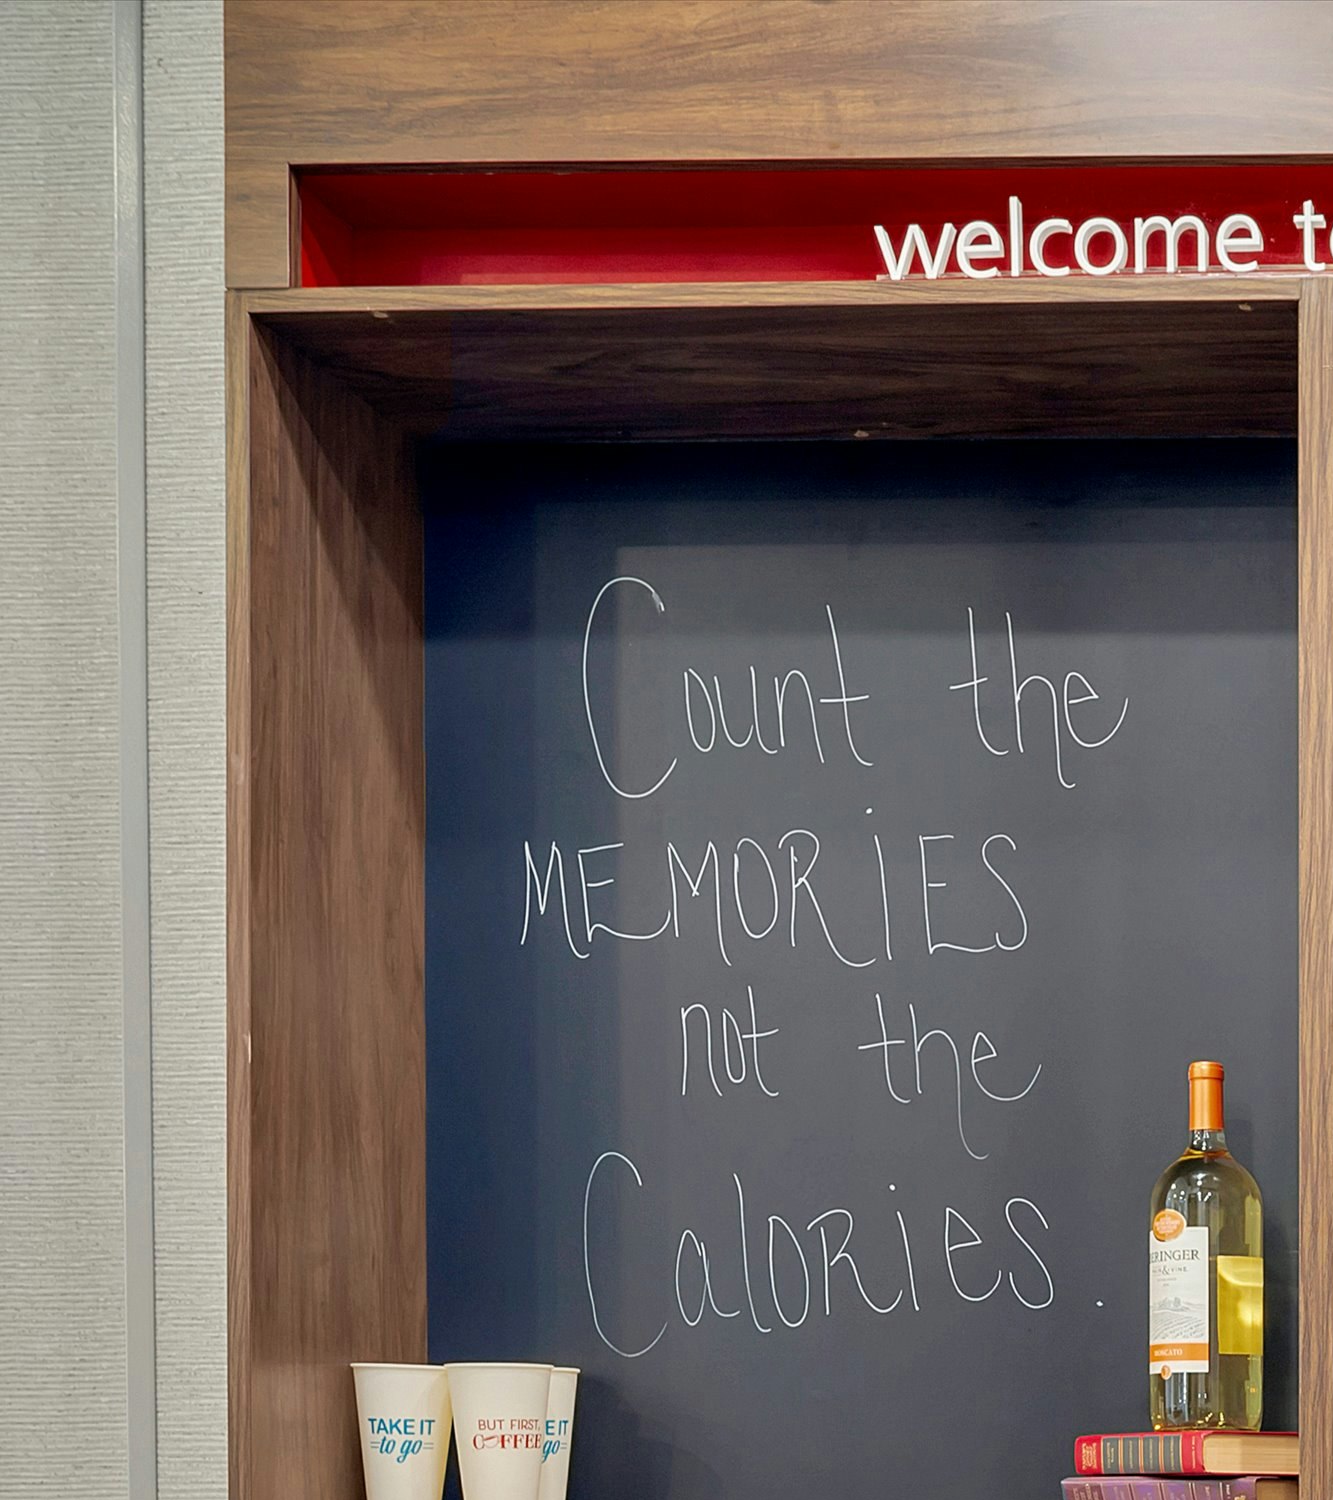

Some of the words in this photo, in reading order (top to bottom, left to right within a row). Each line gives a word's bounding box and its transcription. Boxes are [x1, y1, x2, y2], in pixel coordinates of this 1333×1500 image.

[874, 196, 1264, 281] welcome
[583, 577, 874, 797] Count
[950, 607, 1129, 788] the
[682, 986, 779, 1096] not
[858, 994, 1041, 1159] the
[1150, 1249, 1200, 1264] ERINGER
[368, 1418, 415, 1435] TAKE
[420, 1420, 435, 1435] IT
[478, 1419, 504, 1431] BUT
[558, 1420, 568, 1435] IT
[379, 1435, 396, 1454] to
[397, 1440, 422, 1464] go
